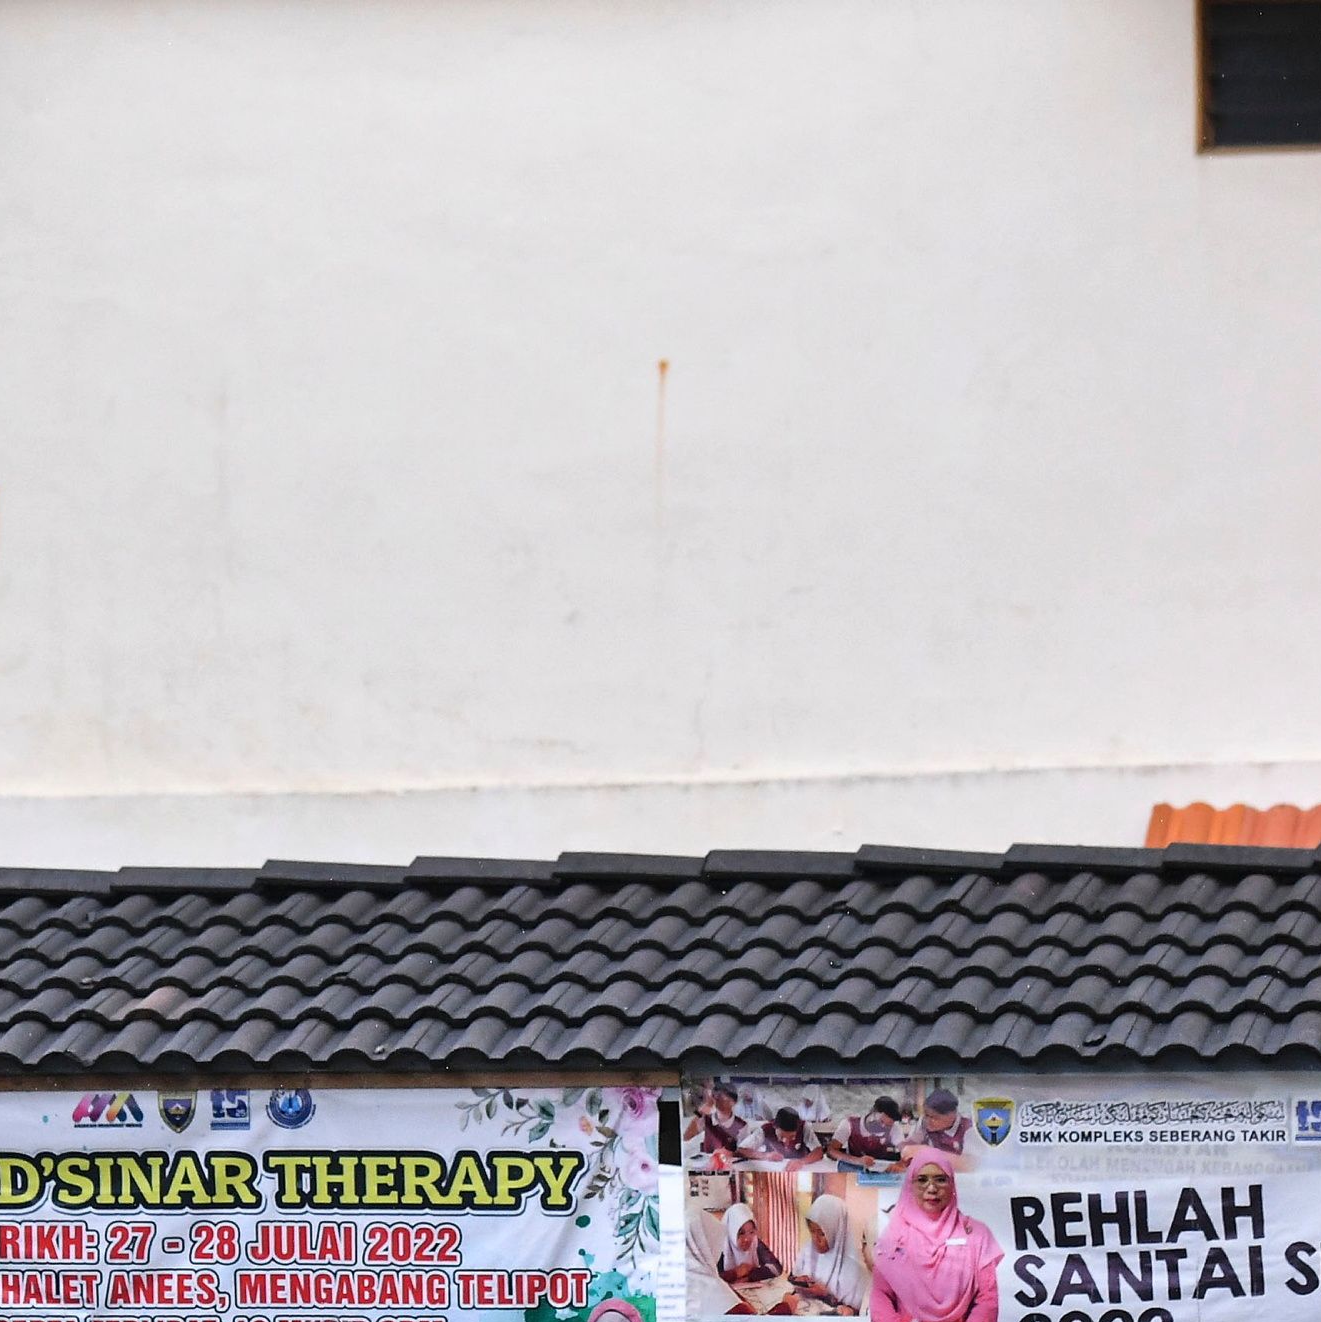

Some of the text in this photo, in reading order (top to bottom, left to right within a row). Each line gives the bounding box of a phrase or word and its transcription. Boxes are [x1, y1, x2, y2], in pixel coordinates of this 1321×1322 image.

[1019, 1129, 1286, 1143] SMK KOMPLEKS SEBERANG TAKIR
[269, 1155, 581, 1207] THERAPY
[1011, 1183, 1266, 1250] REHLAH
[109, 1224, 153, 1261] 27
[194, 1225, 237, 1262] 28
[250, 1225, 353, 1262] JULAI
[367, 1226, 461, 1263] 2022
[110, 1272, 228, 1309] ANEES,
[239, 1273, 446, 1306] MENGABANG
[457, 1272, 591, 1308] TELIPOT
[1013, 1245, 1265, 1308] SANTAI
